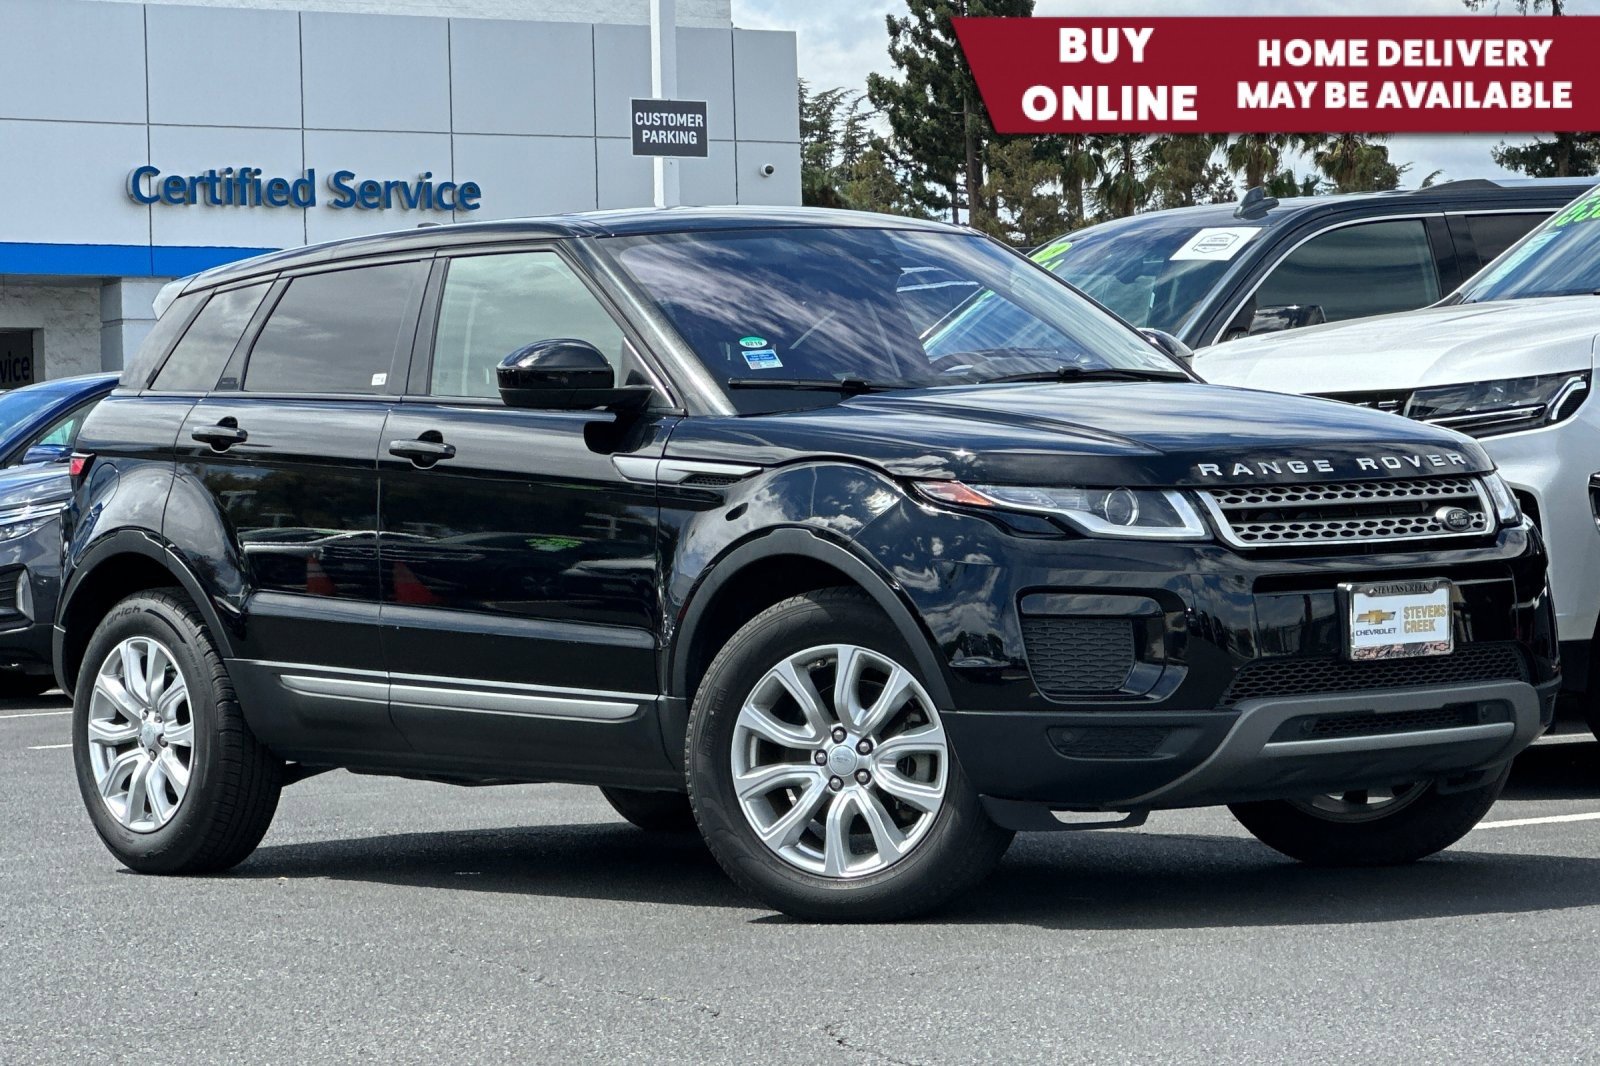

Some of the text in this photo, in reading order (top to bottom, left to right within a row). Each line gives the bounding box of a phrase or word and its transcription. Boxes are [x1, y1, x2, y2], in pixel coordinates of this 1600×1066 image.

[635, 111, 704, 127] CUSTOMER
[642, 129, 698, 144] PARKING
[129, 165, 482, 211] Certified Service
[1198, 453, 1467, 477] RANGE ROVER
[1403, 604, 1447, 620] STEVENS
[1355, 627, 1397, 637] CHEVROLET
[1403, 619, 1436, 634] CREEK
